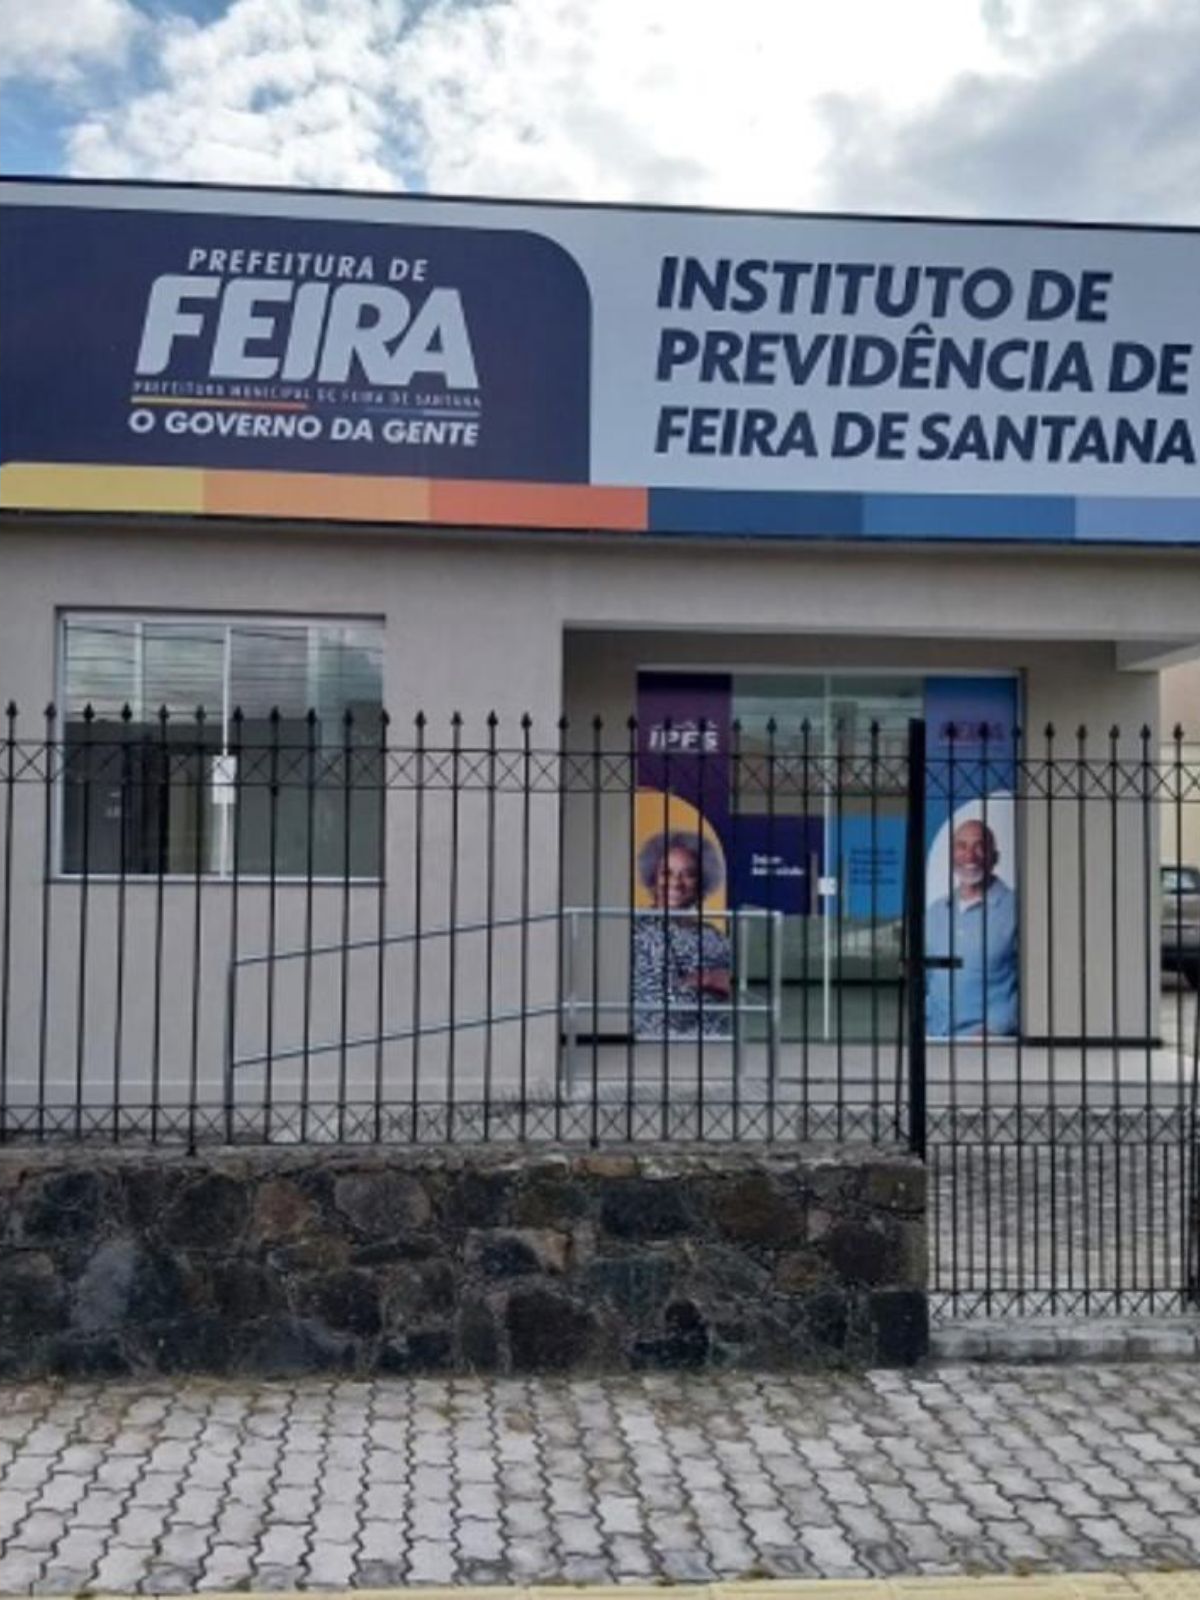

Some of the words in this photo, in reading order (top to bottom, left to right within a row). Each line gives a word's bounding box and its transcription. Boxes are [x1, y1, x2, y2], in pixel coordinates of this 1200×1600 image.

[187, 248, 374, 280] PREFEITURA
[388, 258, 429, 282] DE
[656, 256, 1014, 321] INSTITUTO
[1025, 269, 1114, 323] DE
[135, 273, 480, 390] FEIRA
[654, 321, 1094, 394] PREVIDÊNCIA
[1108, 342, 1193, 395] DE
[128, 409, 156, 434] O
[164, 411, 323, 441] GOVERNO
[330, 417, 374, 442] DA
[382, 419, 480, 447] GENTE
[654, 405, 819, 458] FEIRA
[830, 410, 909, 460] DE
[917, 412, 1196, 465] SANTANA
